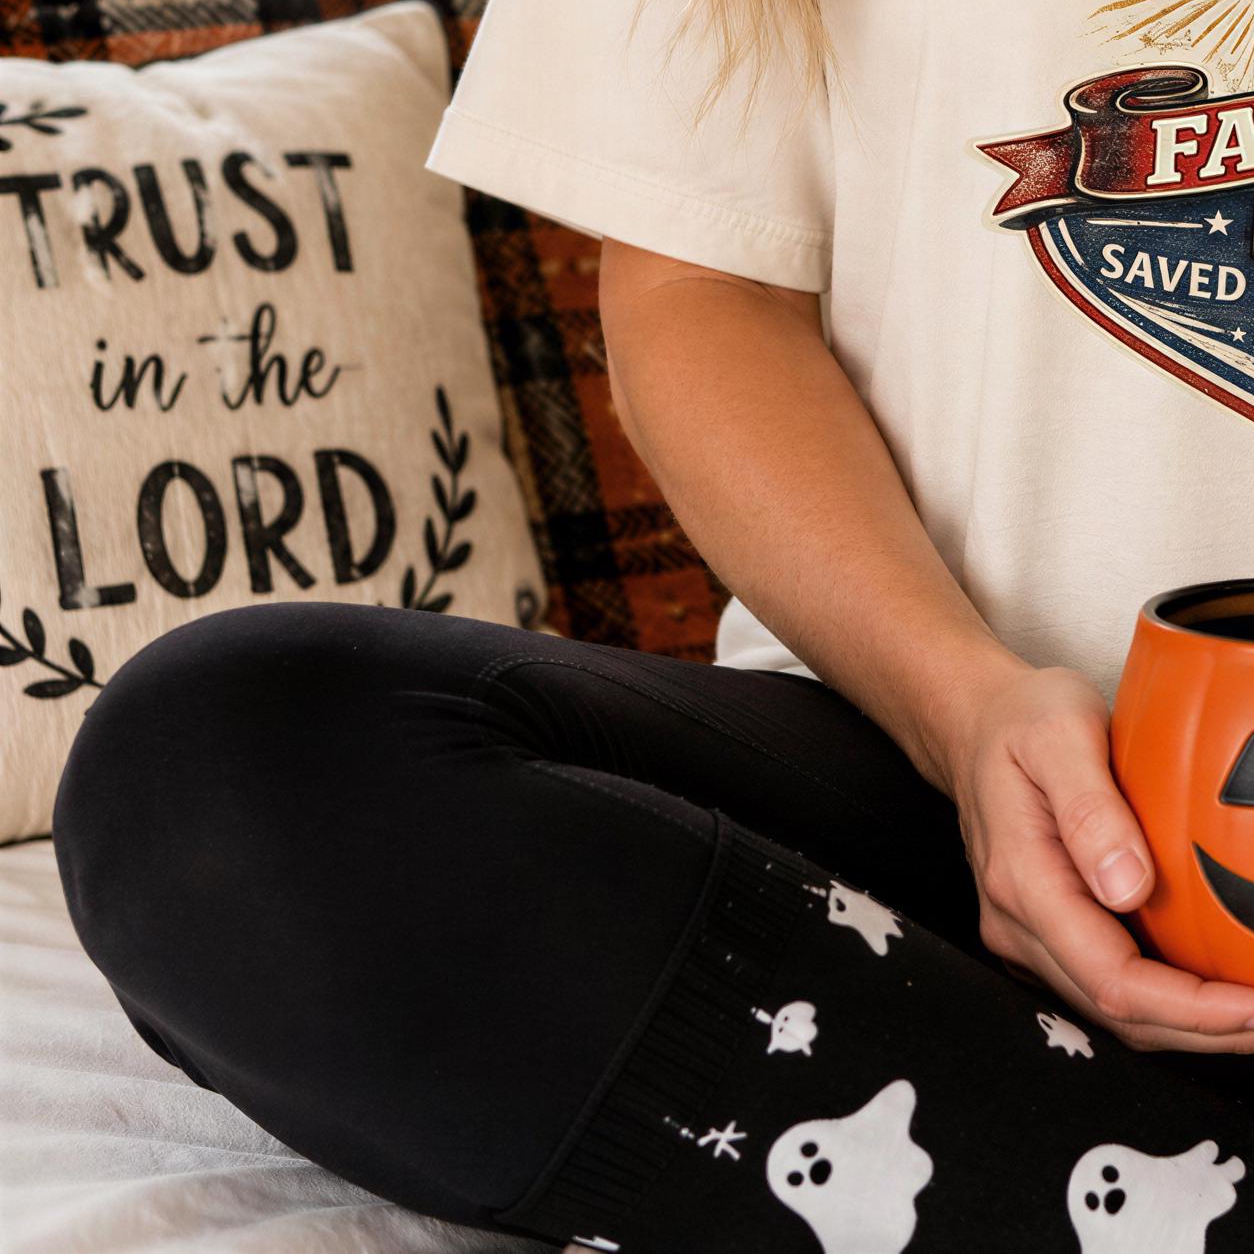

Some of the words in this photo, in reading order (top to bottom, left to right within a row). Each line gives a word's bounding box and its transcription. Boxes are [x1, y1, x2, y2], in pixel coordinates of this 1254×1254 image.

[0, 151, 354, 289] TRUST
[1101, 244, 1247, 303] SAVED
[90, 338, 187, 412] in
[196, 302, 362, 411] the
[40, 448, 397, 611] LORD
